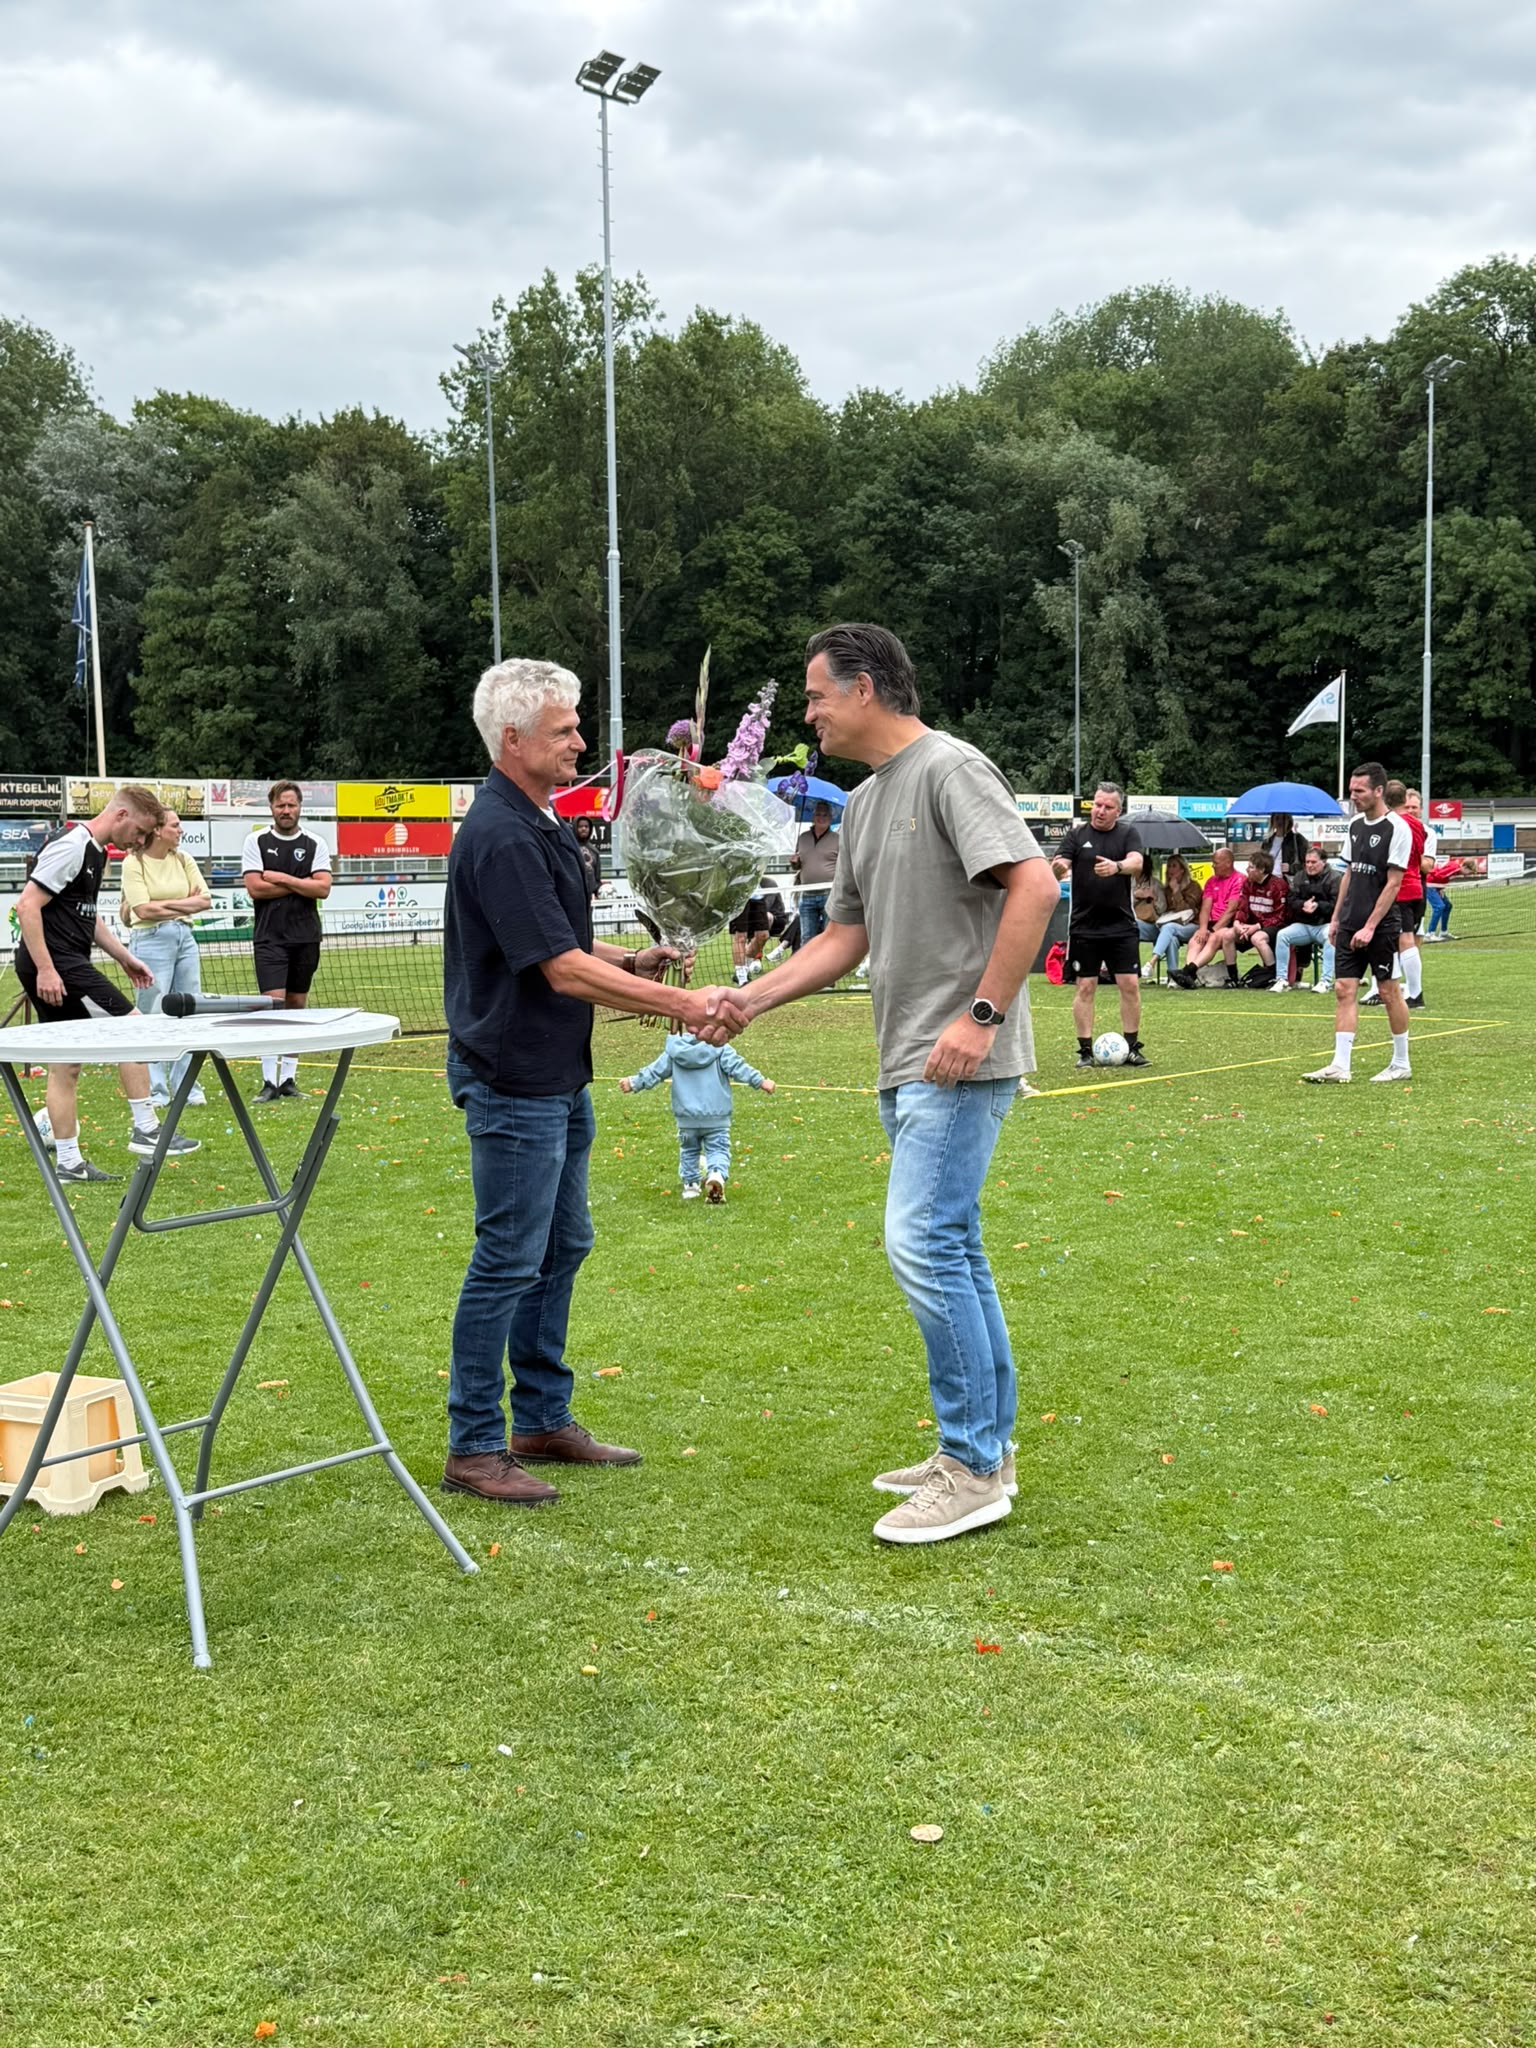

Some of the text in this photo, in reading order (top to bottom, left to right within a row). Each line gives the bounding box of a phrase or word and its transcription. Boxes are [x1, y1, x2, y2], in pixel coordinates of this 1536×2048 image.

[1018, 801, 1039, 812] STOLK
[1051, 801, 1071, 812] STAAL
[1, 829, 30, 840] SEA
[181, 833, 206, 843] Kock
